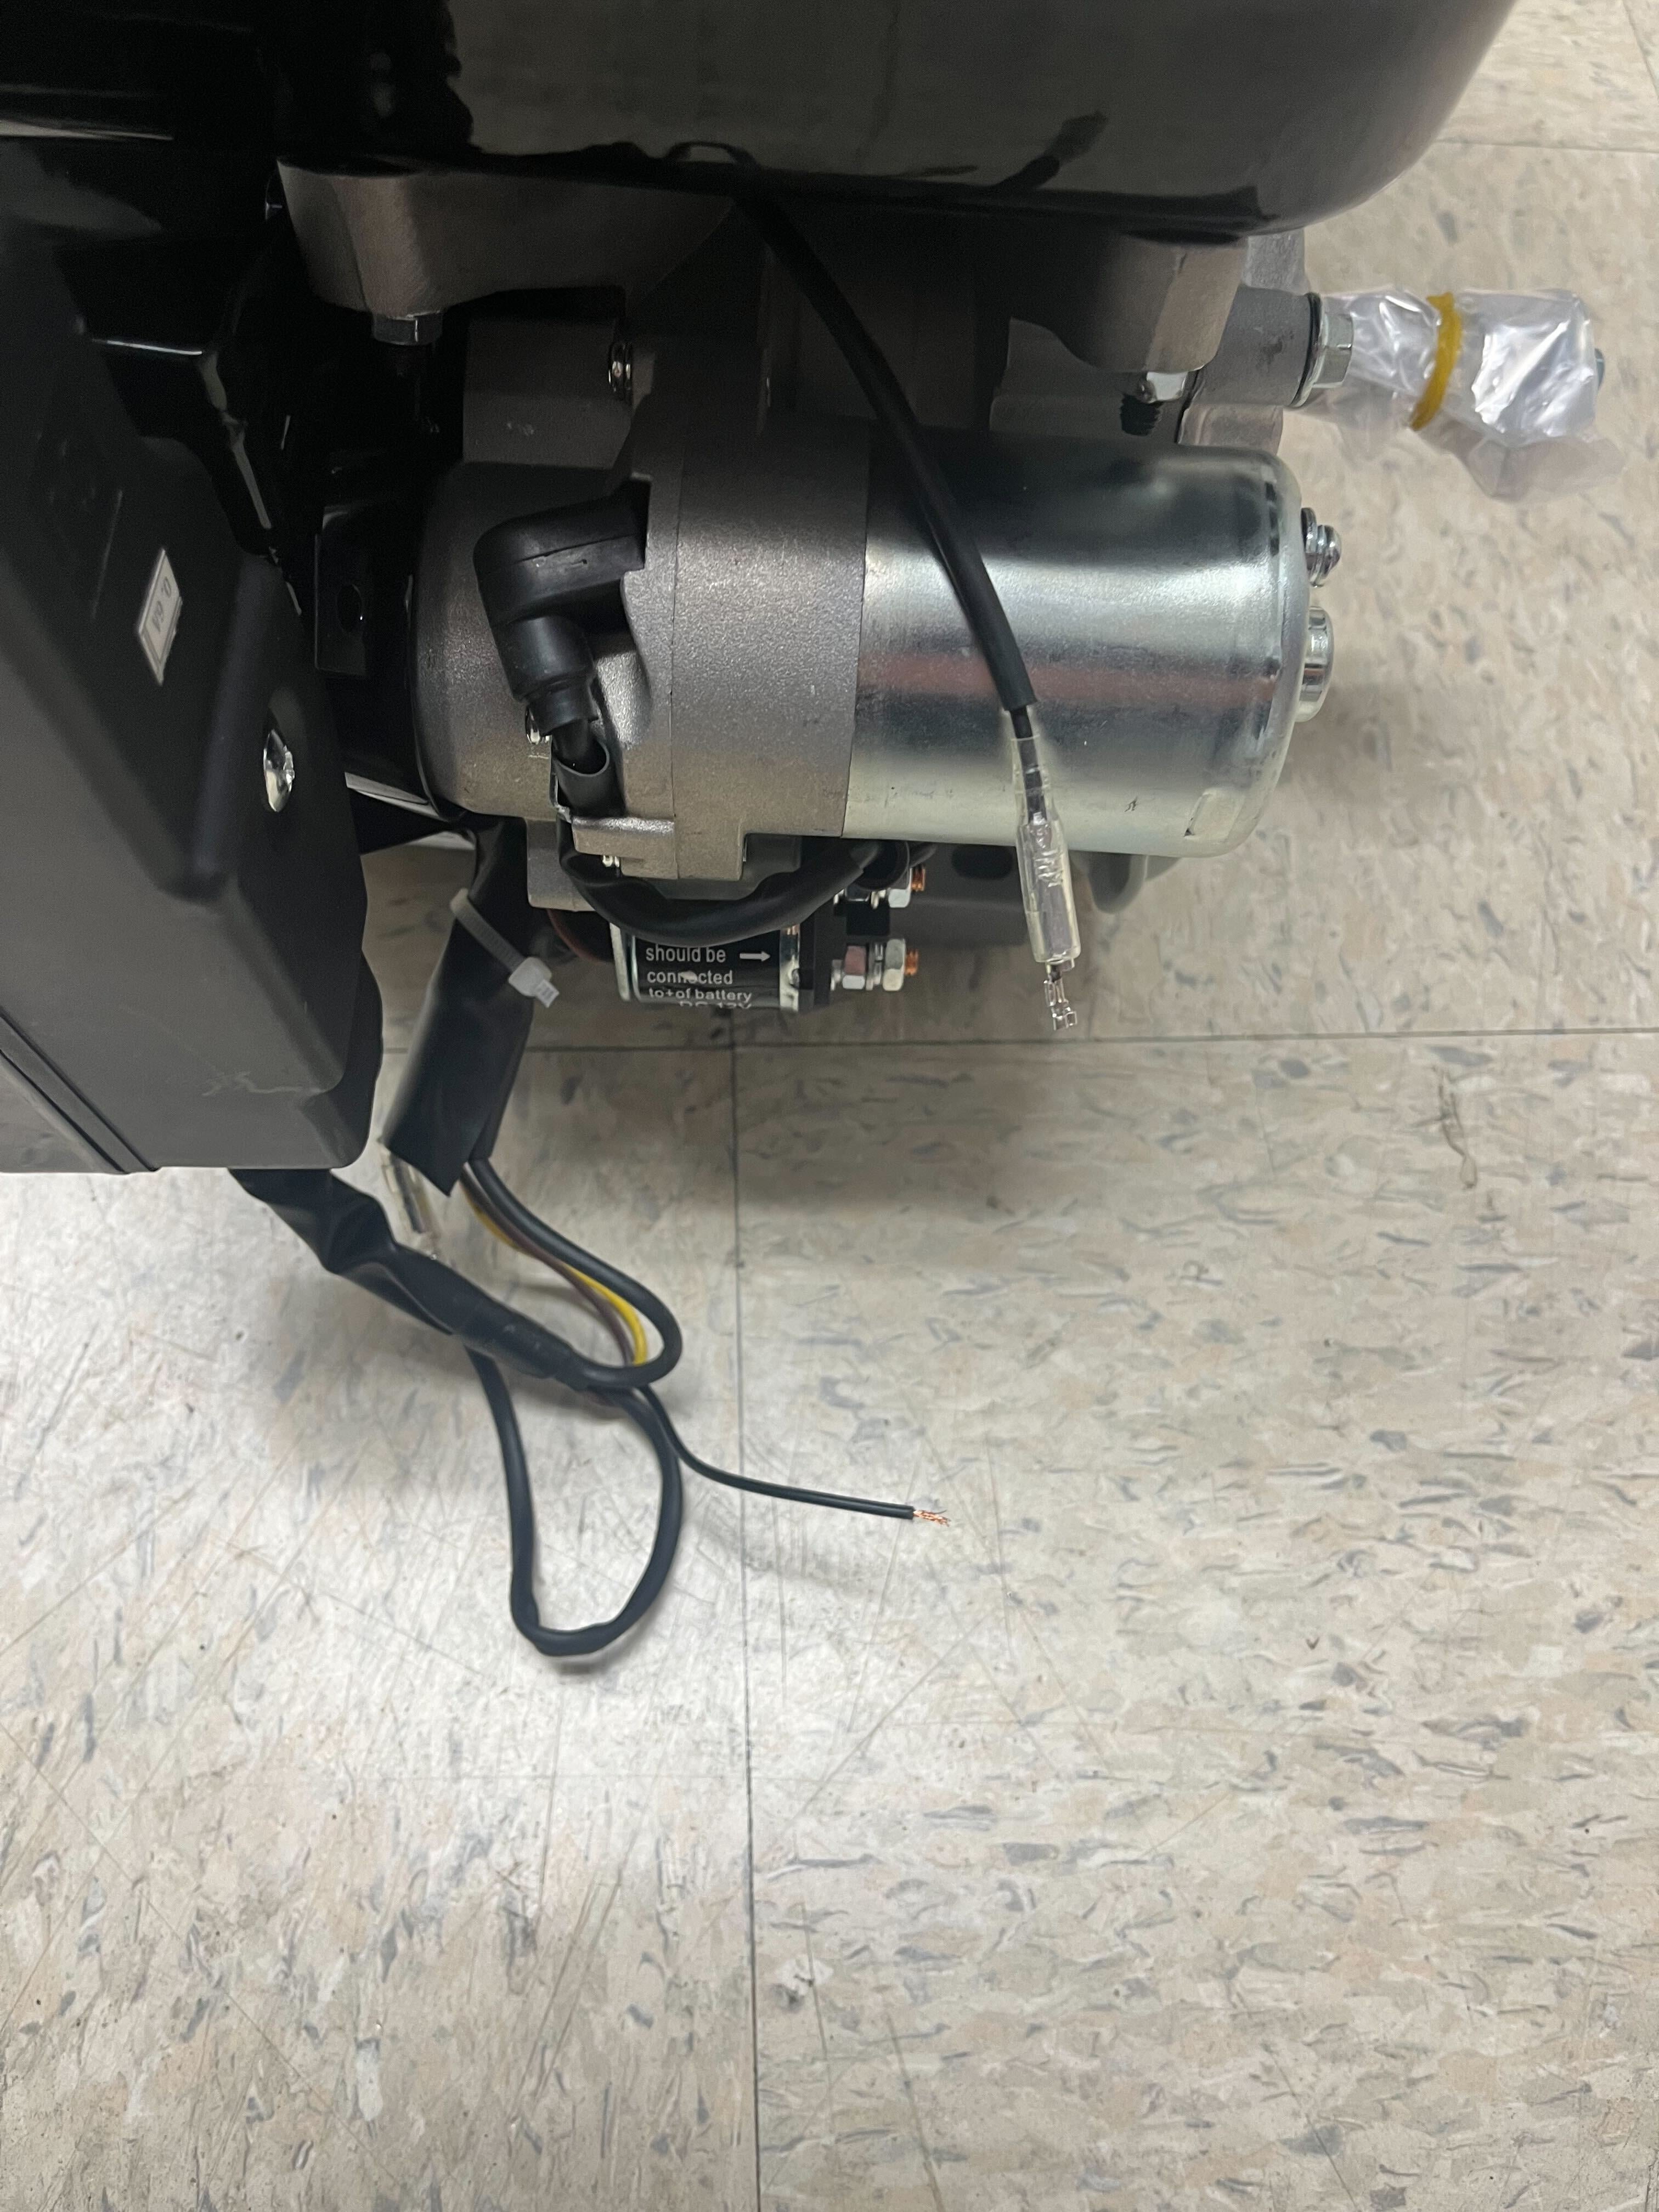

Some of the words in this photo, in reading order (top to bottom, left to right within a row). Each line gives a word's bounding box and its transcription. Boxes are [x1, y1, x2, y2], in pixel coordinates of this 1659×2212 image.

[646, 944, 701, 962] should
[706, 946, 726, 963] be
[695, 989, 752, 1003] battery
